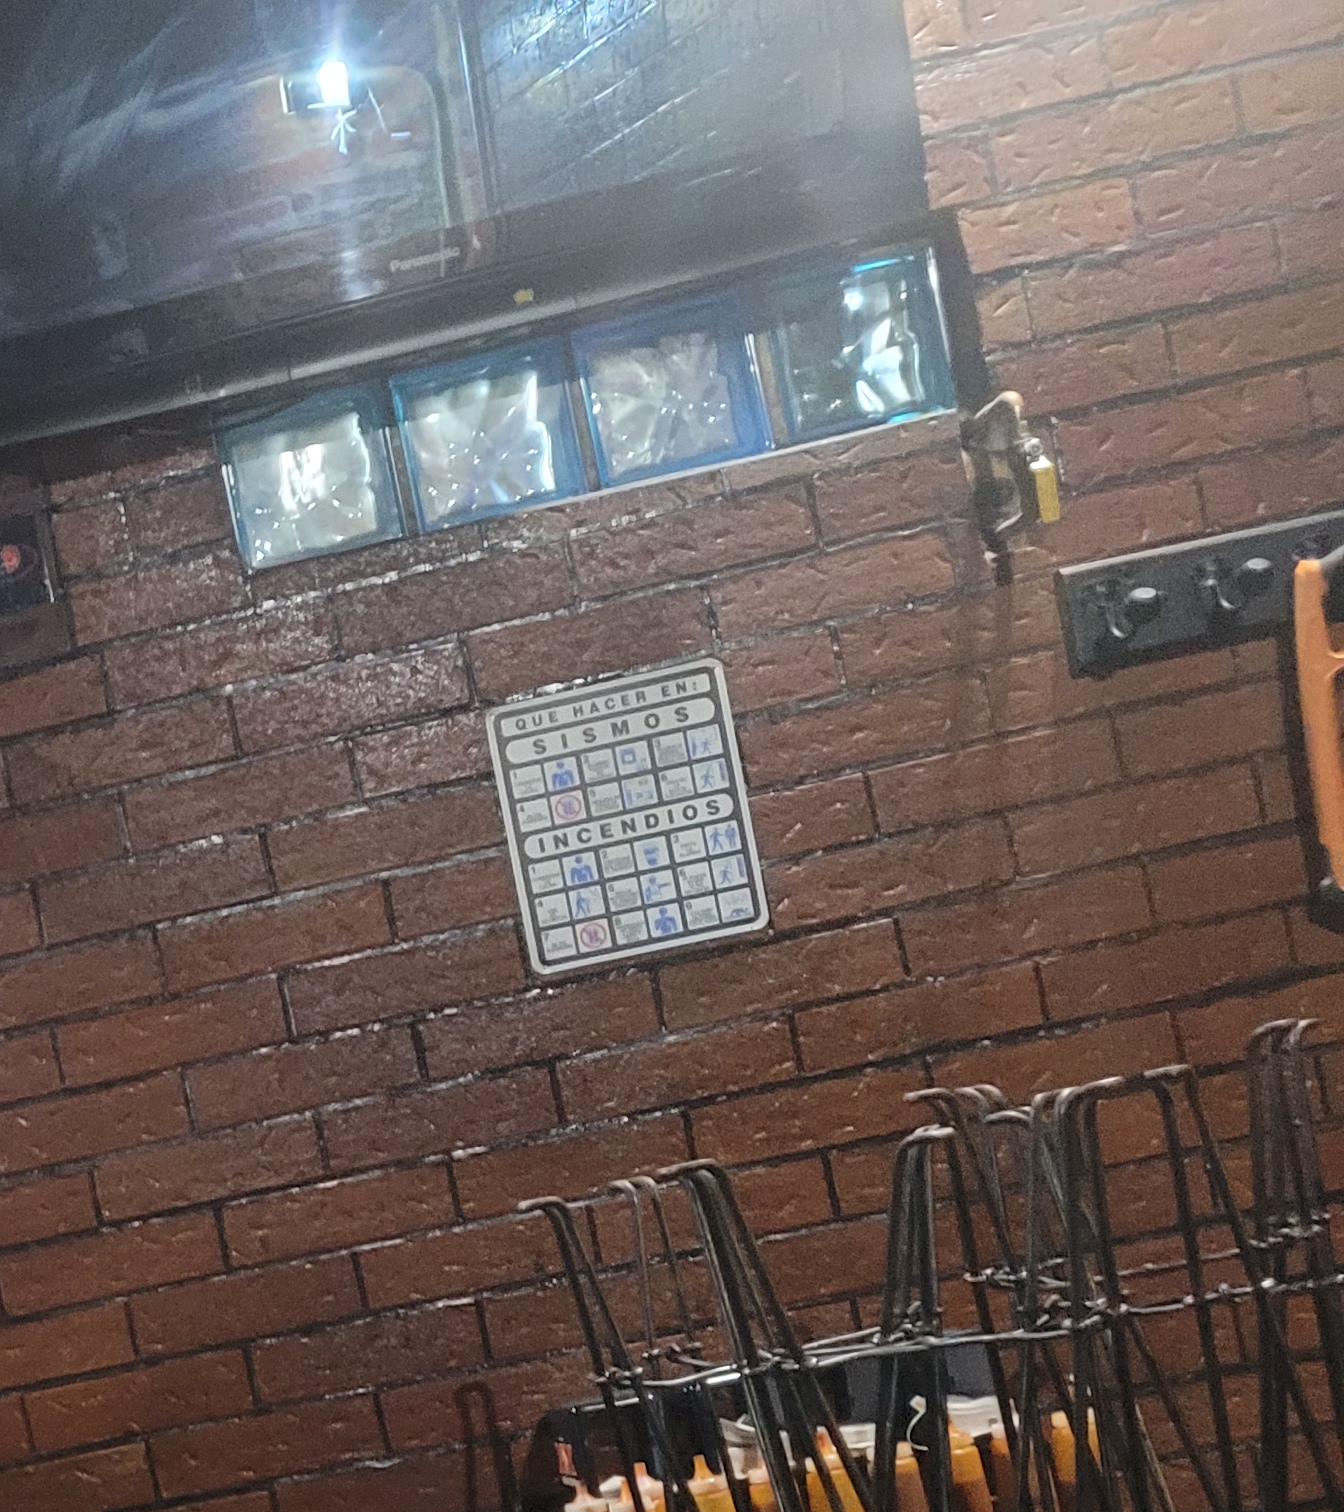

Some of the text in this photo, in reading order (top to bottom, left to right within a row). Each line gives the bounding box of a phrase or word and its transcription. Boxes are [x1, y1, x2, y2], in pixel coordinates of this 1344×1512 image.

[515, 711, 558, 731] QUE
[572, 690, 647, 718] HACER
[532, 706, 690, 755] SISMOS
[538, 800, 722, 855] INCENDIOS
